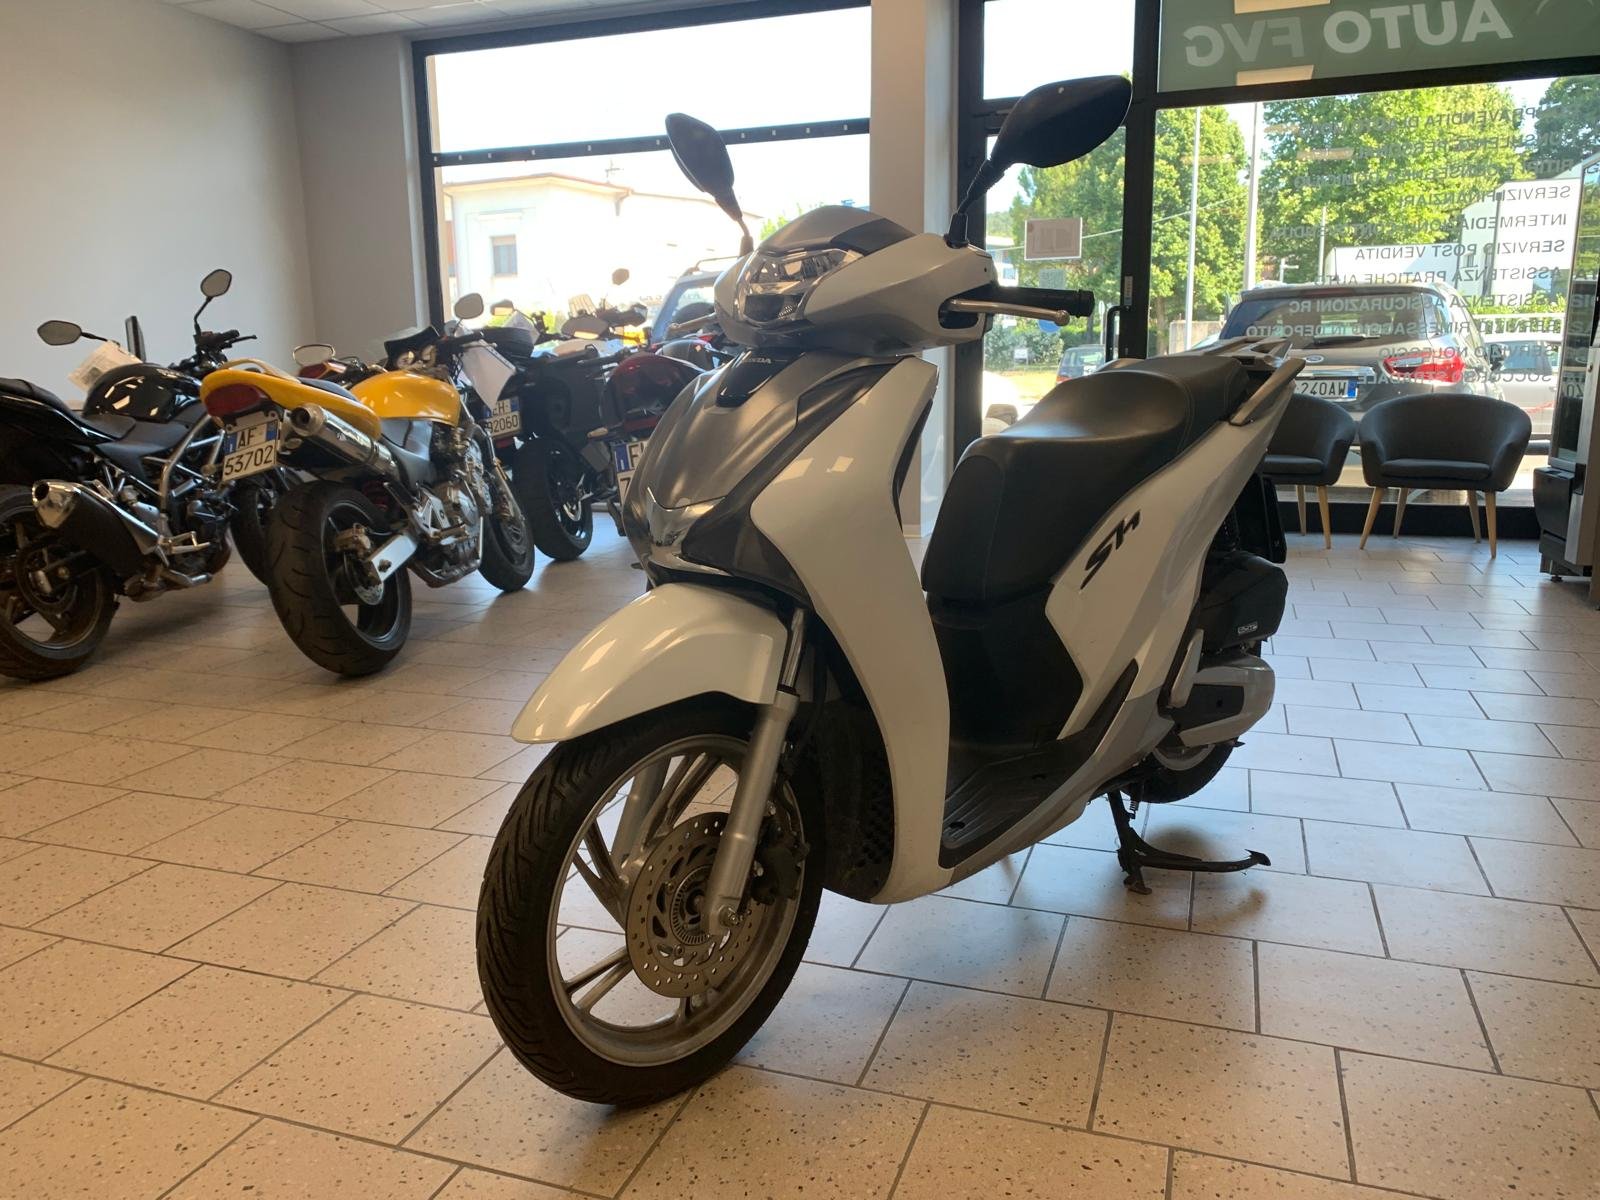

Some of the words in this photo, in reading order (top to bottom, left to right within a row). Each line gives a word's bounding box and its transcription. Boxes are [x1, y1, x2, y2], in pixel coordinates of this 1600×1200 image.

[238, 427, 256, 448] AF
[224, 445, 274, 476] 53702
[1080, 508, 1141, 591] SH
